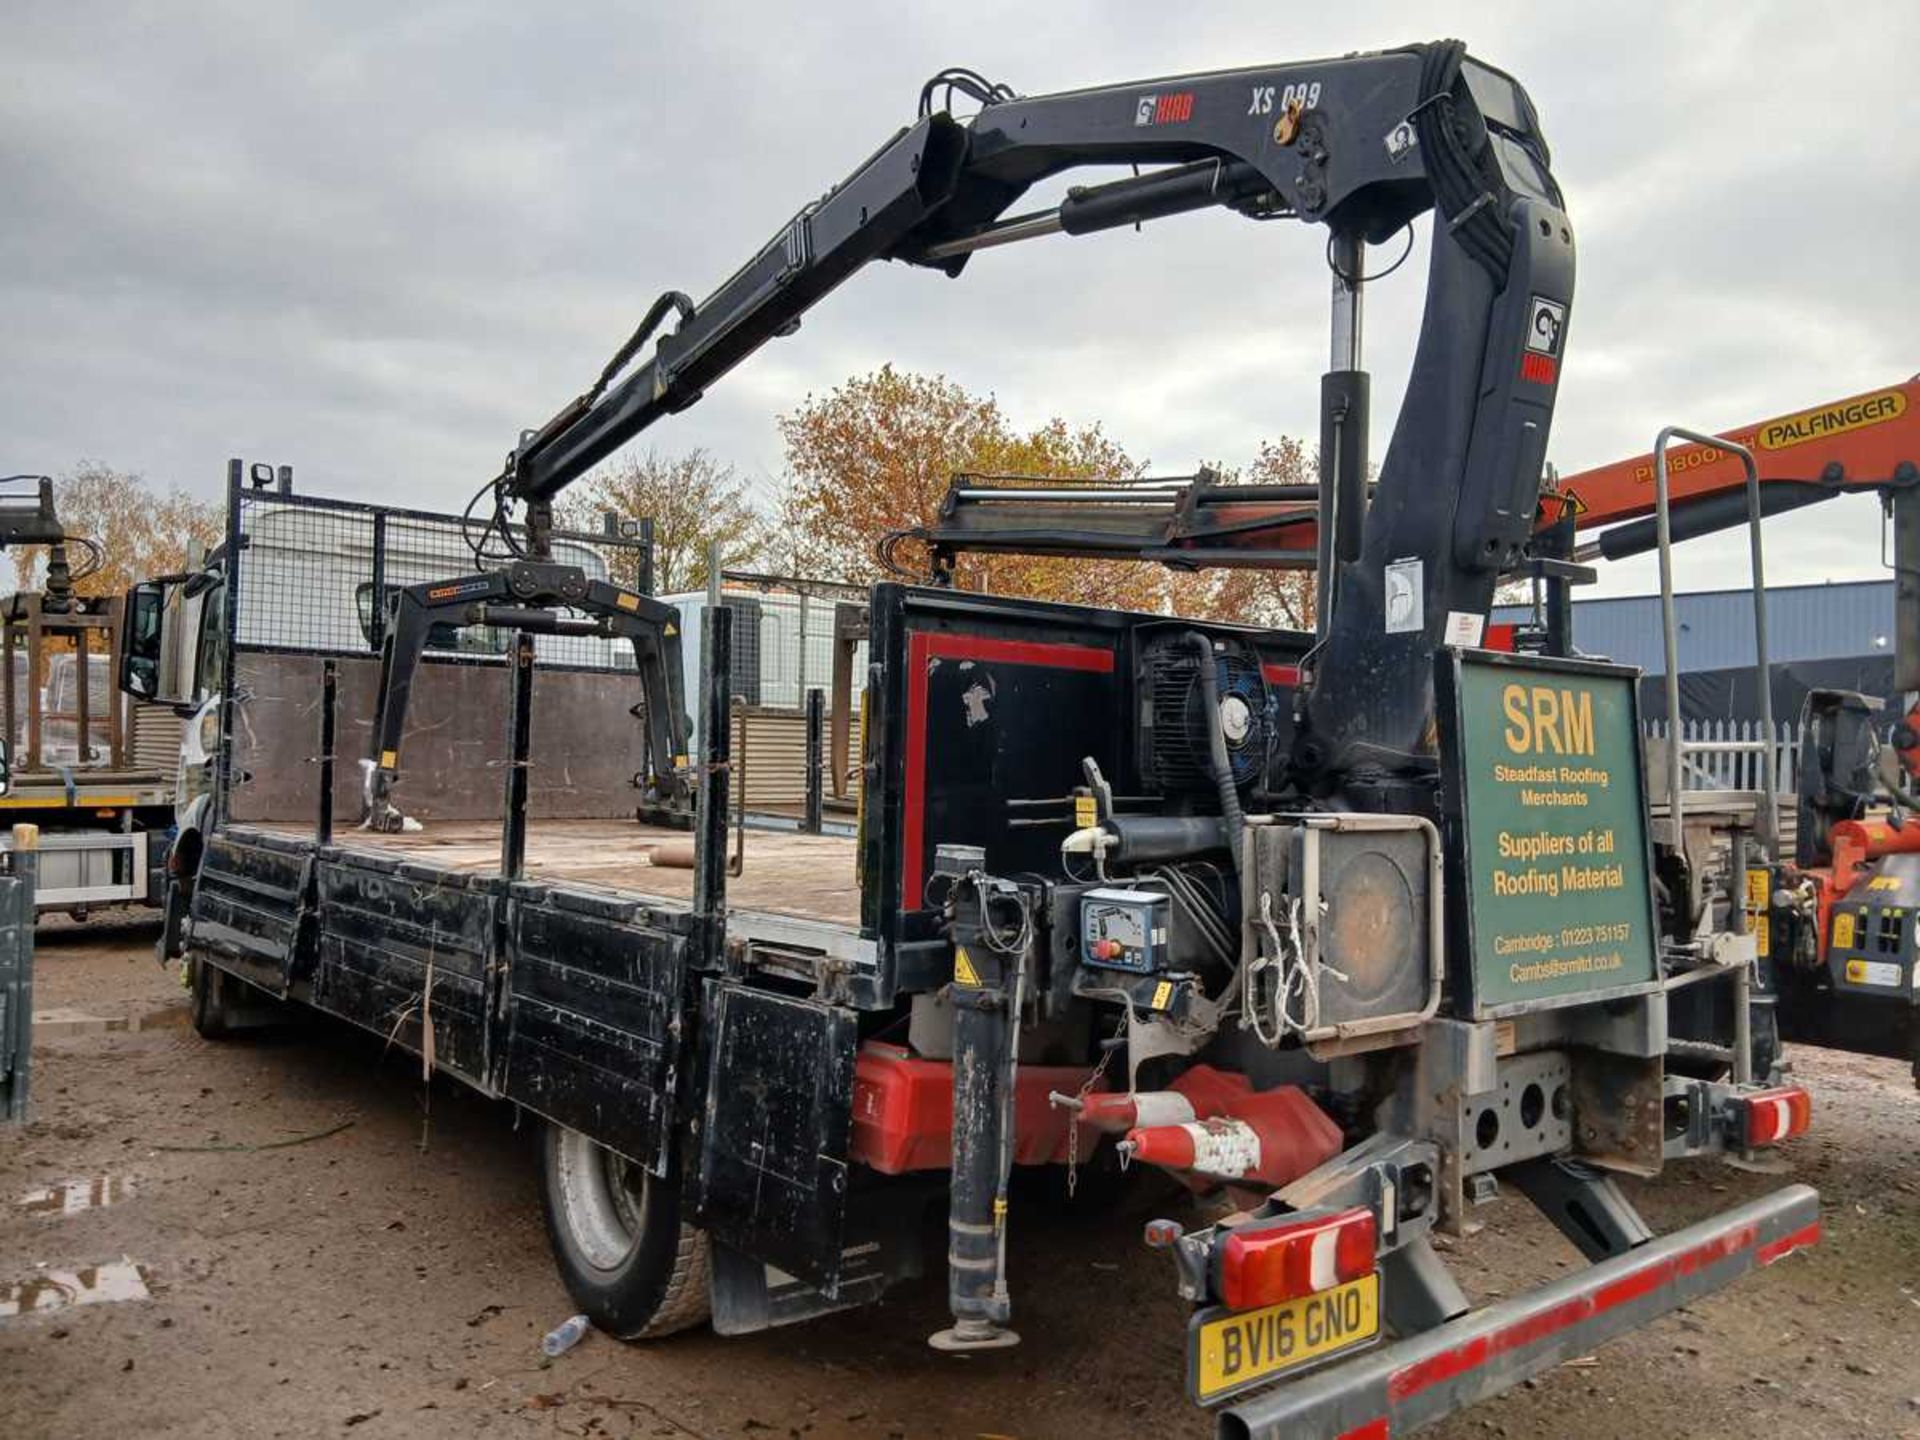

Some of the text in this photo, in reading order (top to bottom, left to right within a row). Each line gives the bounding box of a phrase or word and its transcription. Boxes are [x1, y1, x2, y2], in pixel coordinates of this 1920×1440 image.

[1248, 86, 1275, 115] XS
[1768, 396, 1897, 444] PALFINGER
[1504, 684, 1594, 755] SRM
[1495, 765, 1608, 788] Steadfast Roofing
[1522, 790, 1588, 806] Merchants
[1499, 829, 1613, 861] Suppliers of all
[1494, 863, 1623, 896] Roofing Material
[1222, 1288, 1360, 1376] BV16 GNO
